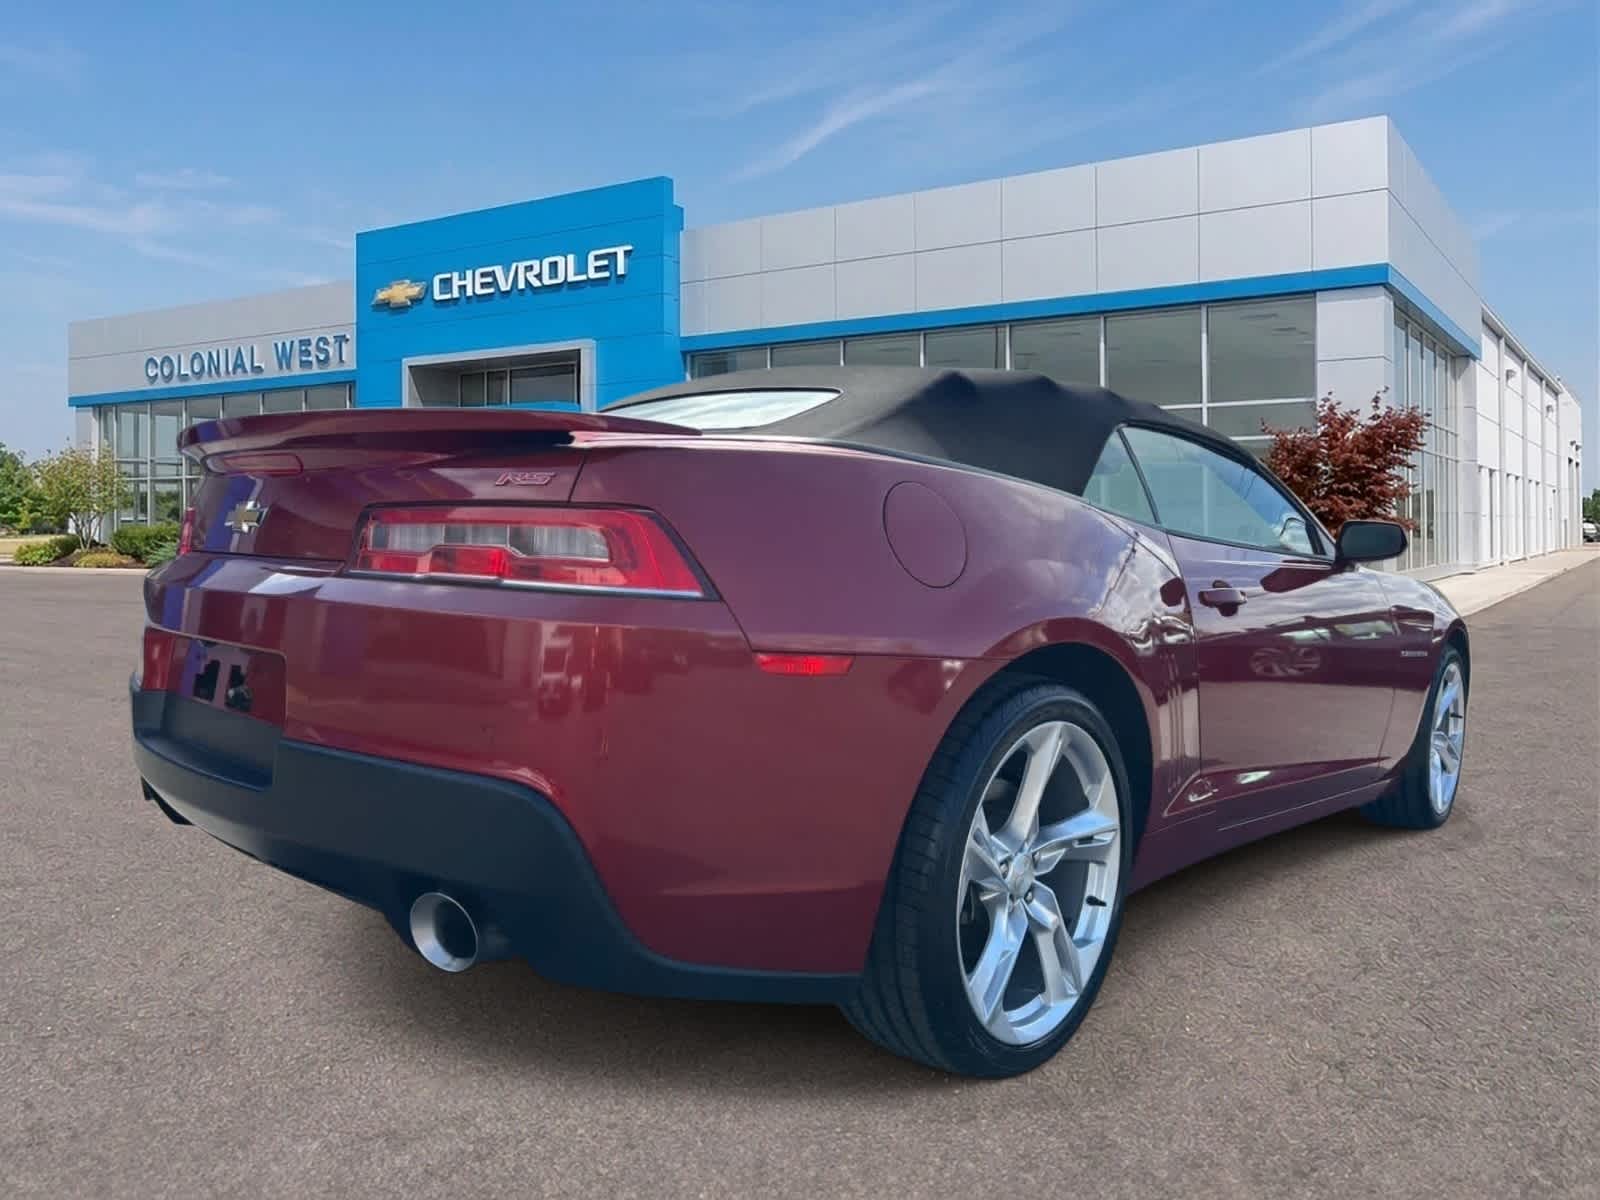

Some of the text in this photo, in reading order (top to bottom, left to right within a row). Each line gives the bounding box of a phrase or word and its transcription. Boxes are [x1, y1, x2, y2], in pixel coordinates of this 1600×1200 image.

[433, 245, 633, 301] CHEVROLET
[145, 334, 349, 383] COLONIAL WEST
[495, 471, 556, 486] RS
